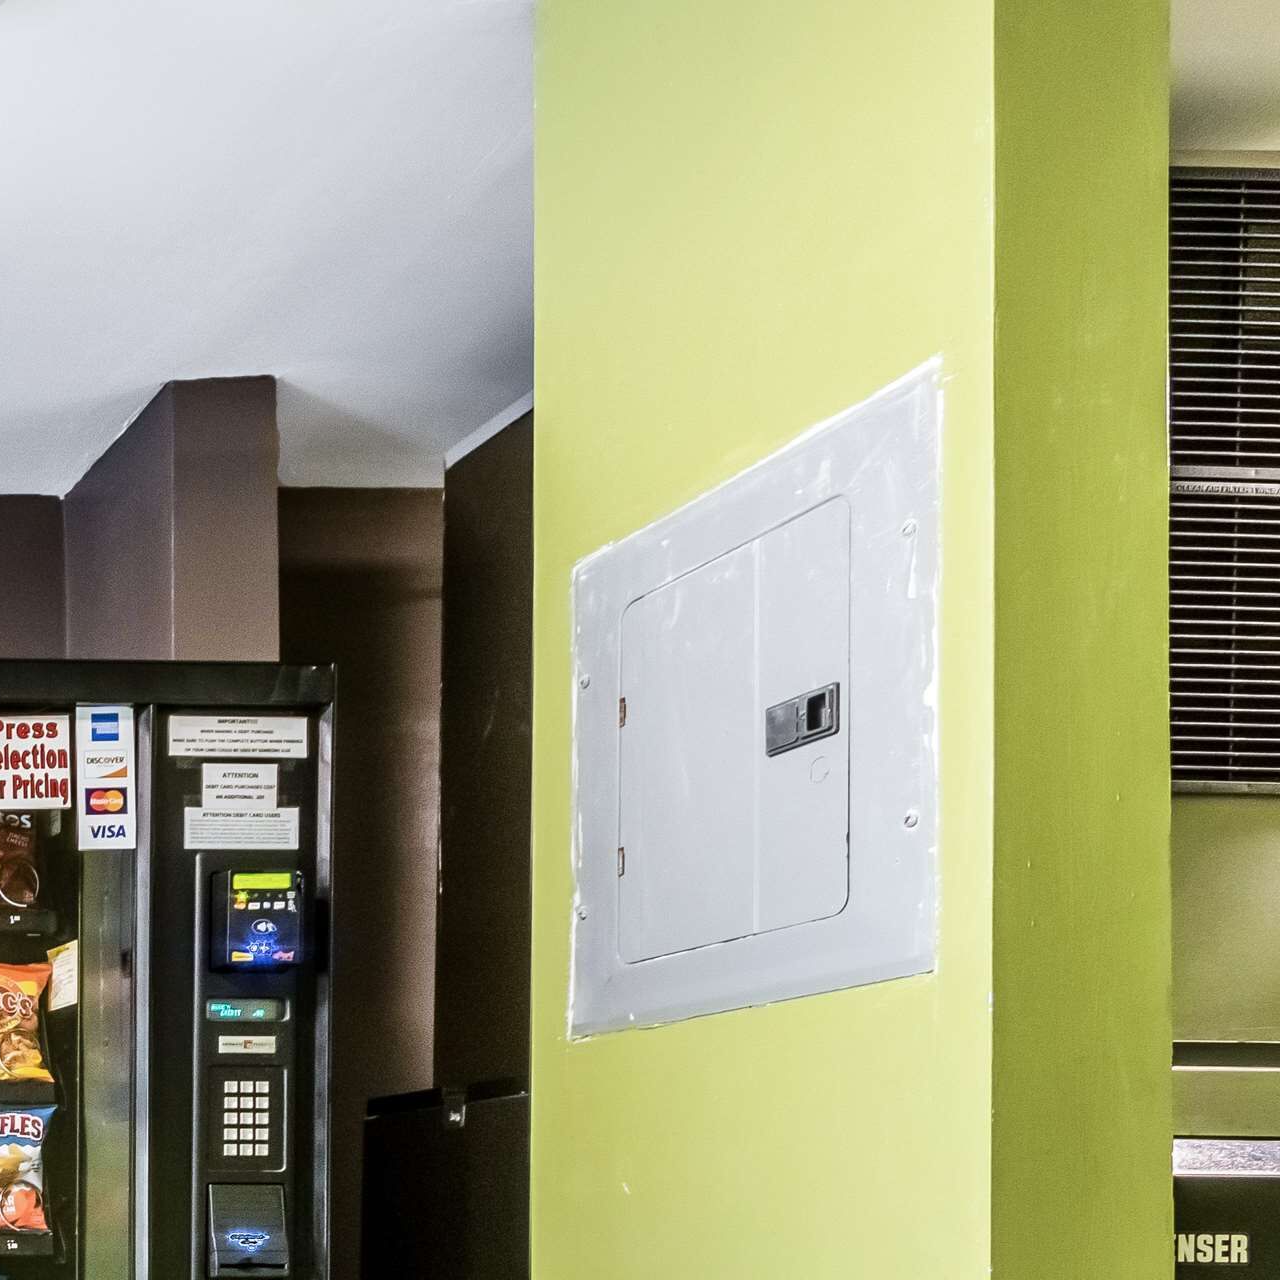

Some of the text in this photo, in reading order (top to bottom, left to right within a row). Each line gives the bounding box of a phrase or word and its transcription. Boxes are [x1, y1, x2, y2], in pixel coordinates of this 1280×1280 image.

[86, 756, 125, 765] DISCOVER
[12, 773, 69, 805] Pricing
[90, 825, 127, 838] VISA
[1173, 1233, 1248, 1264] NSER
